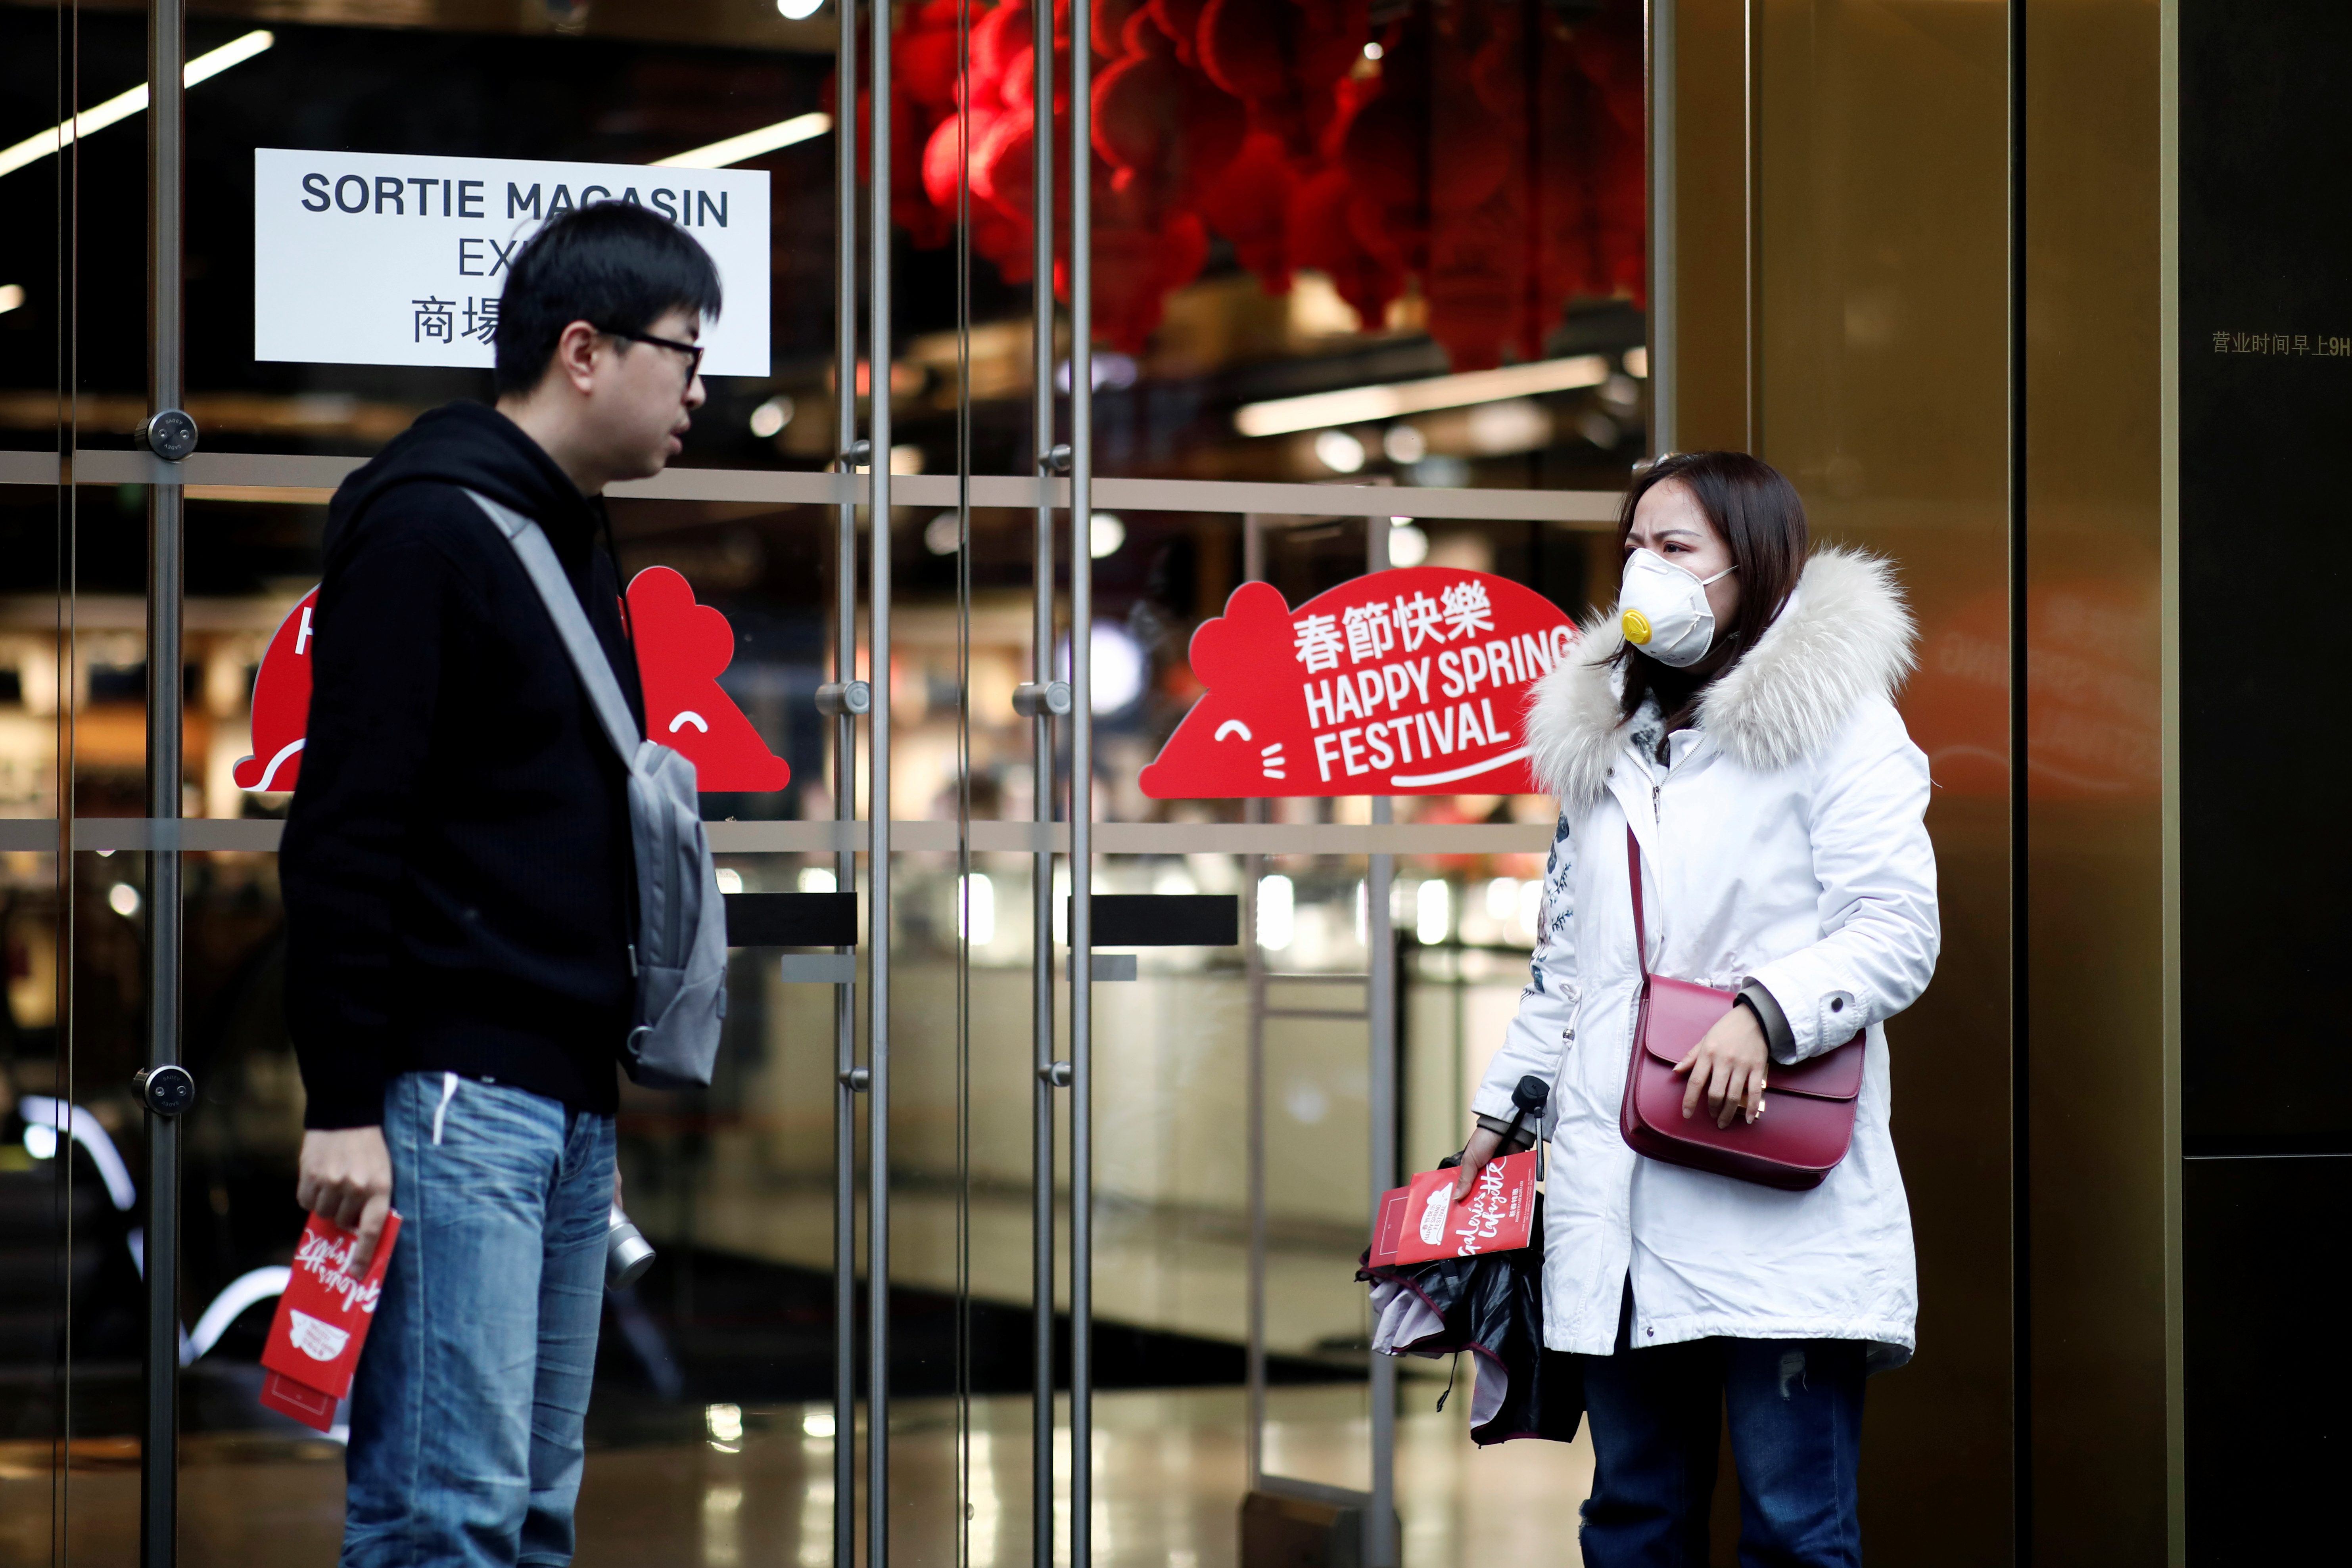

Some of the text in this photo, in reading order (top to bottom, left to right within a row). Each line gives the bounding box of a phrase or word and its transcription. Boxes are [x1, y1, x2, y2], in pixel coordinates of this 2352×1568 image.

[301, 173, 485, 219] SORTIE
[459, 238, 528, 277] EX
[411, 295, 500, 346] 商場
[2212, 331, 2352, 356] 营业时间早上9H
[1293, 580, 1494, 675] 春節快樂
[1303, 625, 1575, 730] HAPPY SPRING
[1314, 698, 1510, 782] FESTIVAL
[1433, 1205, 1446, 1230] FESTIVAL
[1478, 1156, 1507, 1238] Lafayette
[1423, 1204, 1441, 1240] HAPPY SPRING
[1455, 1192, 1486, 1257] Galeries
[294, 1228, 357, 1274] fayette
